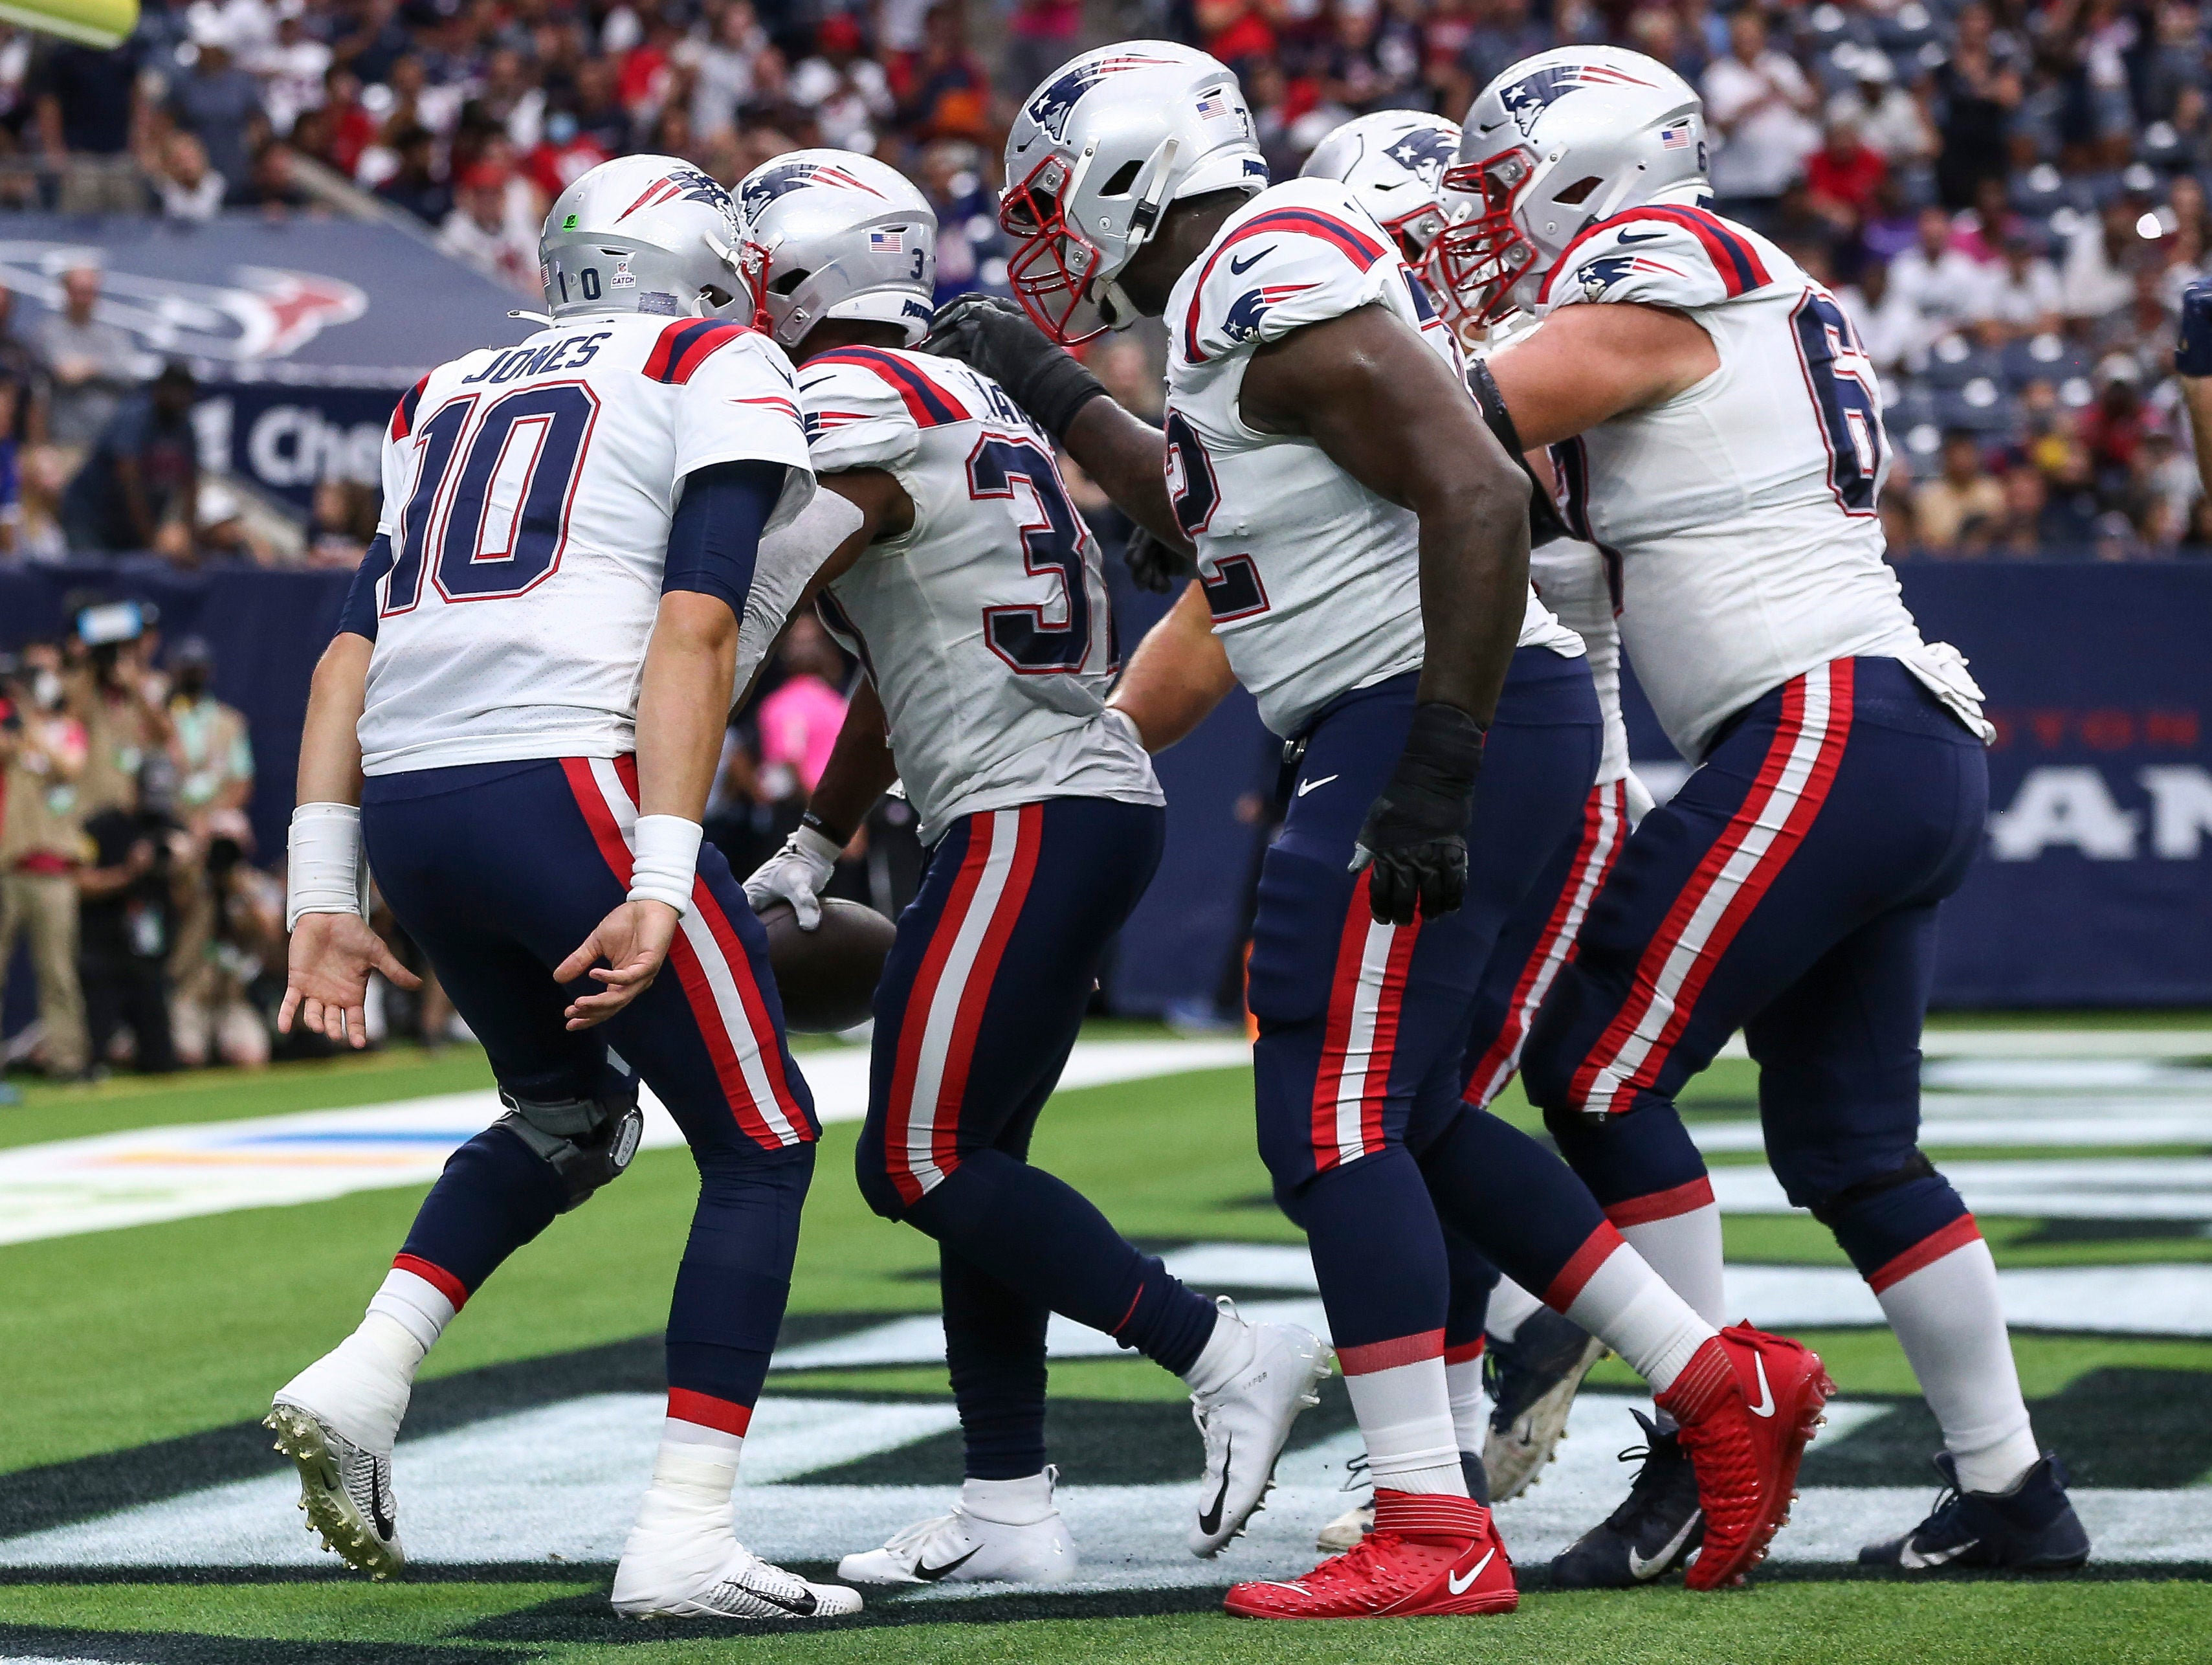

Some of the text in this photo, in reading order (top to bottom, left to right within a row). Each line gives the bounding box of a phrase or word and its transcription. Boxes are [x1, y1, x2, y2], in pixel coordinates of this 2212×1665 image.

[557, 267, 602, 304] 10
[612, 276, 635, 285] CATCH
[910, 247, 924, 280] 3
[461, 332, 612, 384] JONES
[1788, 285, 1883, 518] 6
[379, 379, 601, 619] 10
[965, 430, 1121, 675] 3
